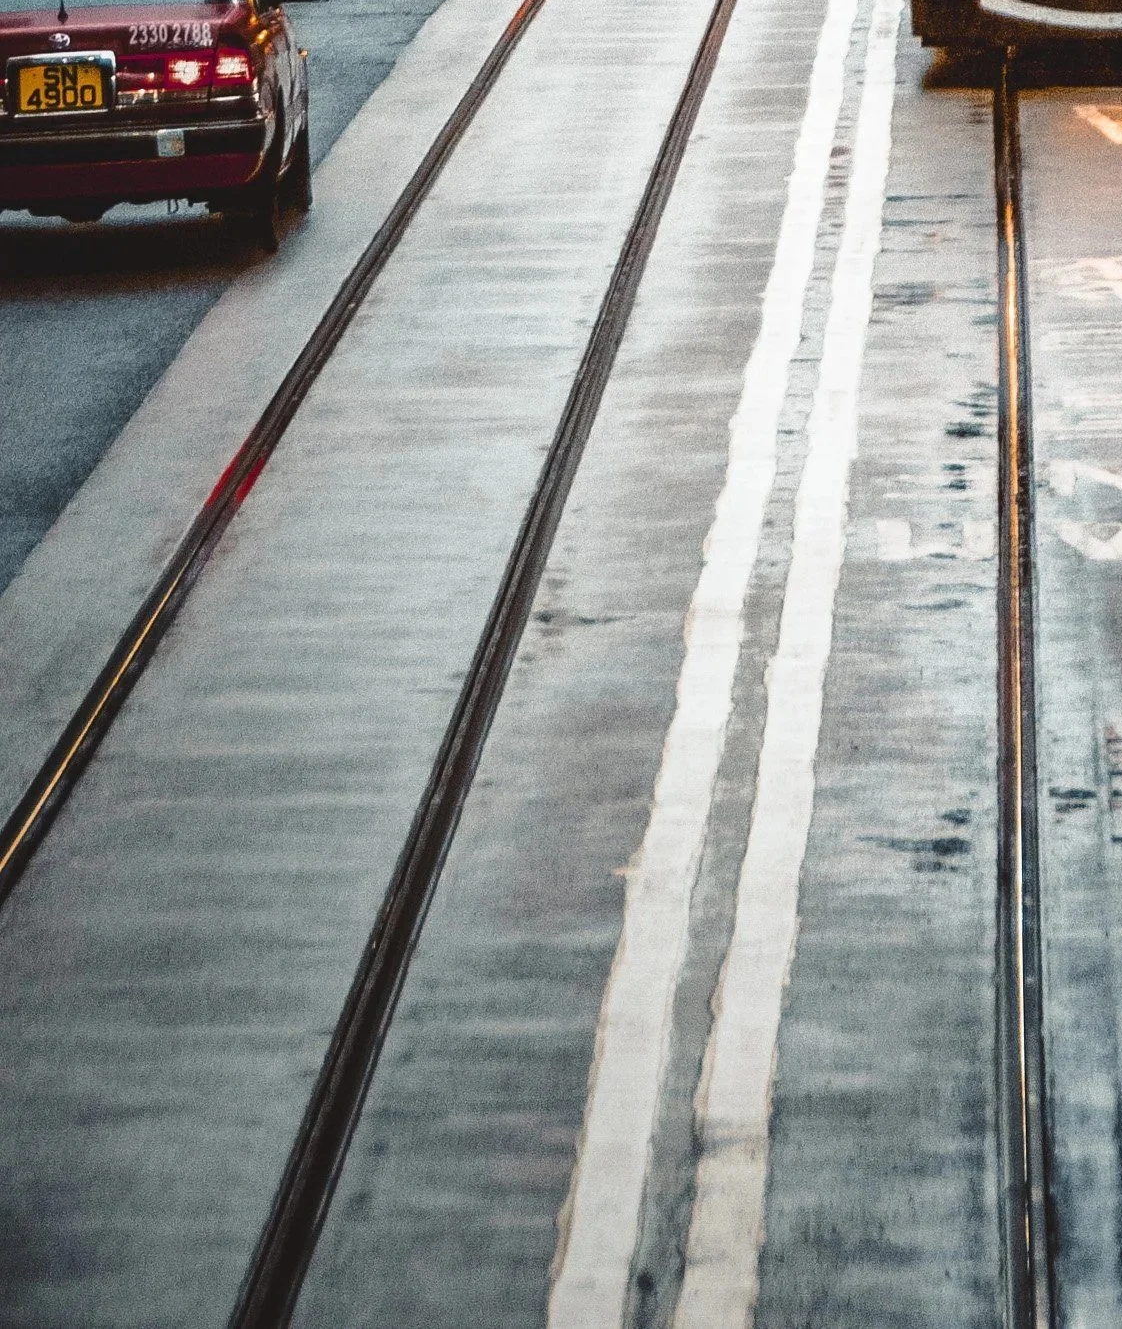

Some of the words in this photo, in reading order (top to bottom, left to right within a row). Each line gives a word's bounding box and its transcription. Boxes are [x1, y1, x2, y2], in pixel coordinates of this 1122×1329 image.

[129, 24, 168, 45] 2330
[172, 22, 212, 44] 2788
[43, 66, 79, 88] SN
[26, 85, 97, 109] 4900
